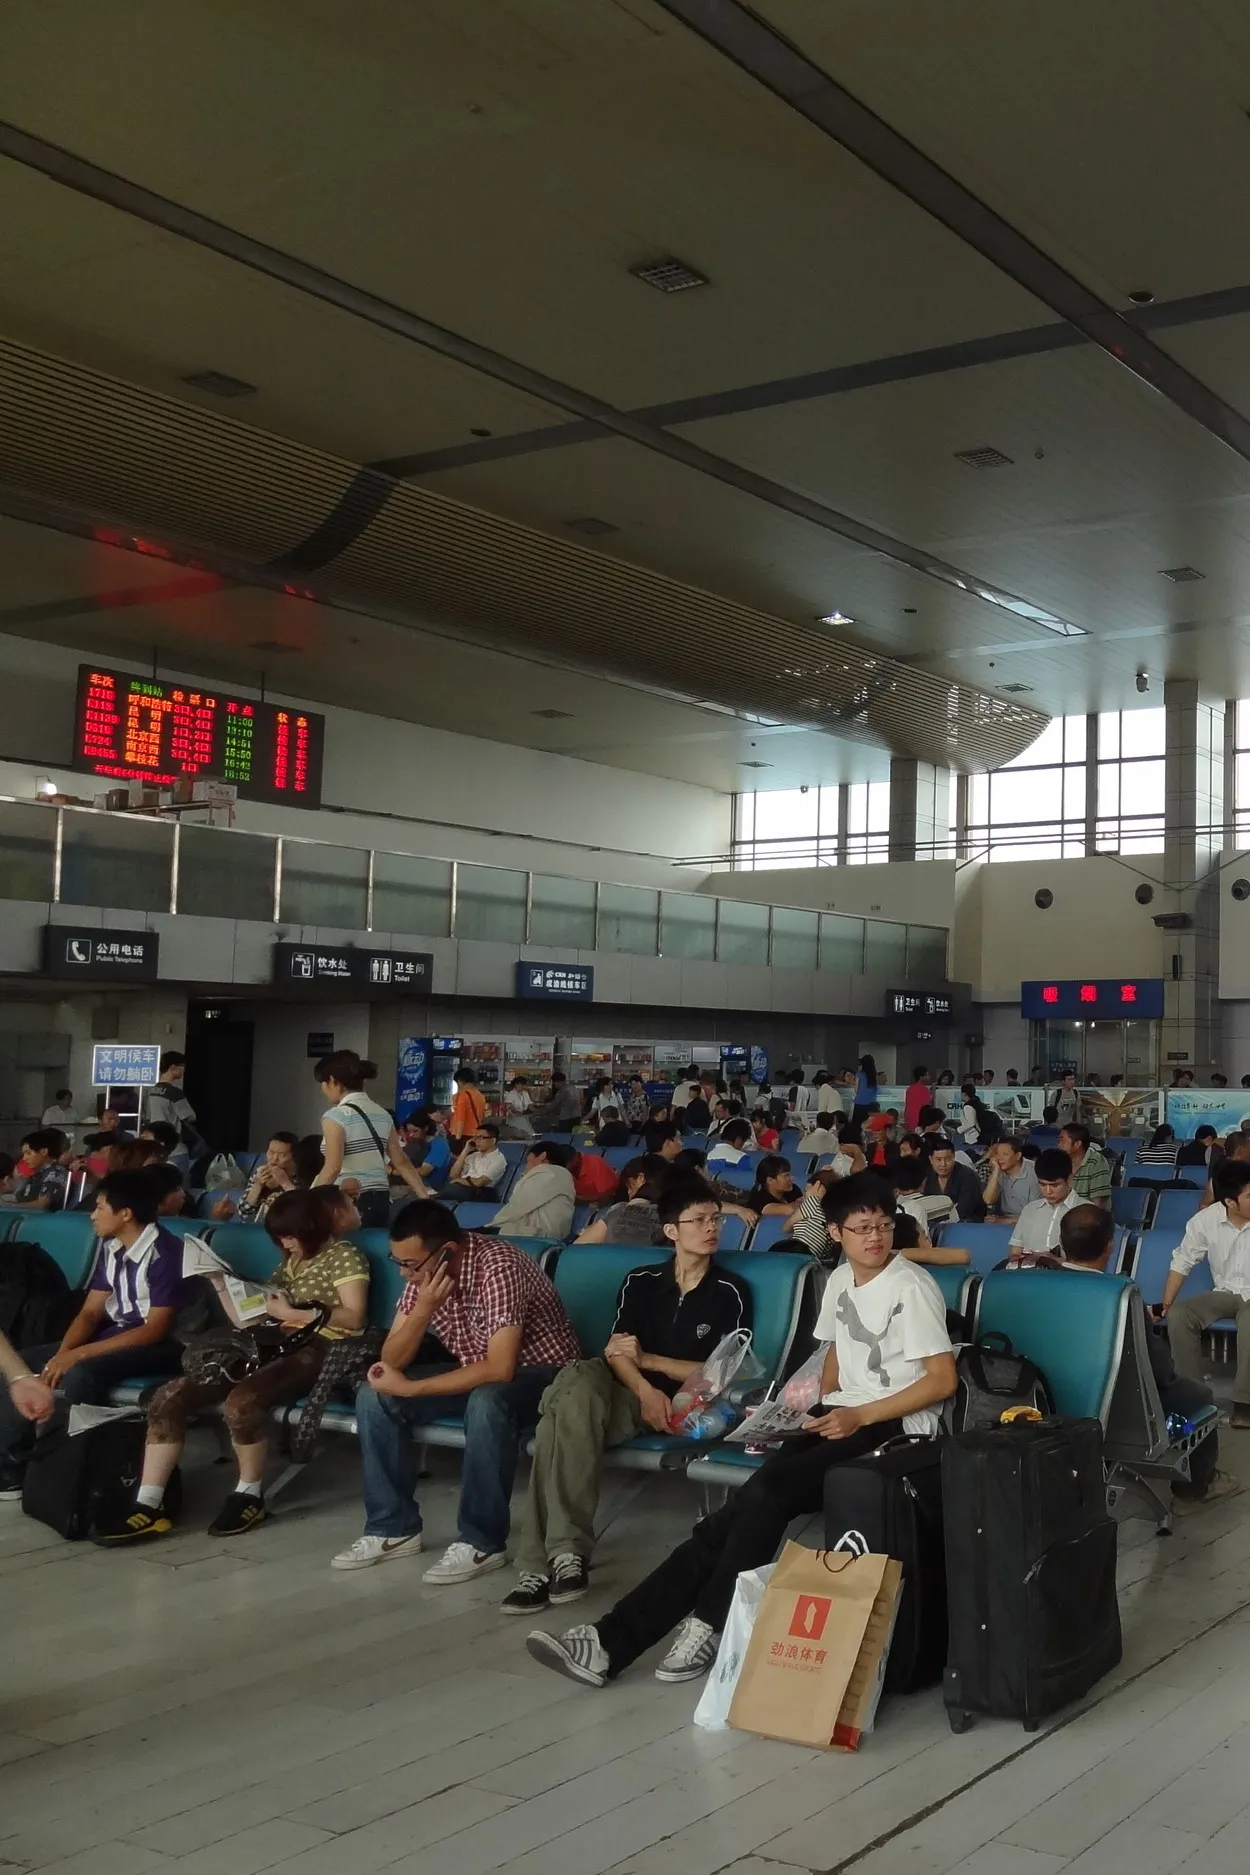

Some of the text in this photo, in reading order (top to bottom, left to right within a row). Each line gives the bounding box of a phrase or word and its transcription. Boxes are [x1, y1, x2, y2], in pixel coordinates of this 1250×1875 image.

[89, 673, 114, 688] 车次
[226, 702, 254, 717] 开点
[128, 694, 173, 712] 呼和浩特
[227, 714, 253, 727] 11:00
[226, 725, 253, 738] 13:10
[126, 729, 160, 744] 北京西
[225, 747, 252, 759] 15:50
[126, 740, 160, 755] 南京西
[225, 736, 251, 748] 14:51
[96, 942, 145, 957] 公用电话
[317, 957, 348, 969] 饮水处
[394, 961, 425, 975] 卫生间
[394, 974, 411, 983] Toilet
[1042, 984, 1137, 1003] 吸烟室
[98, 1048, 156, 1064] 文明候车
[98, 1066, 154, 1081] 请勿躺卧
[770, 1641, 829, 1665] 劲浪体育
